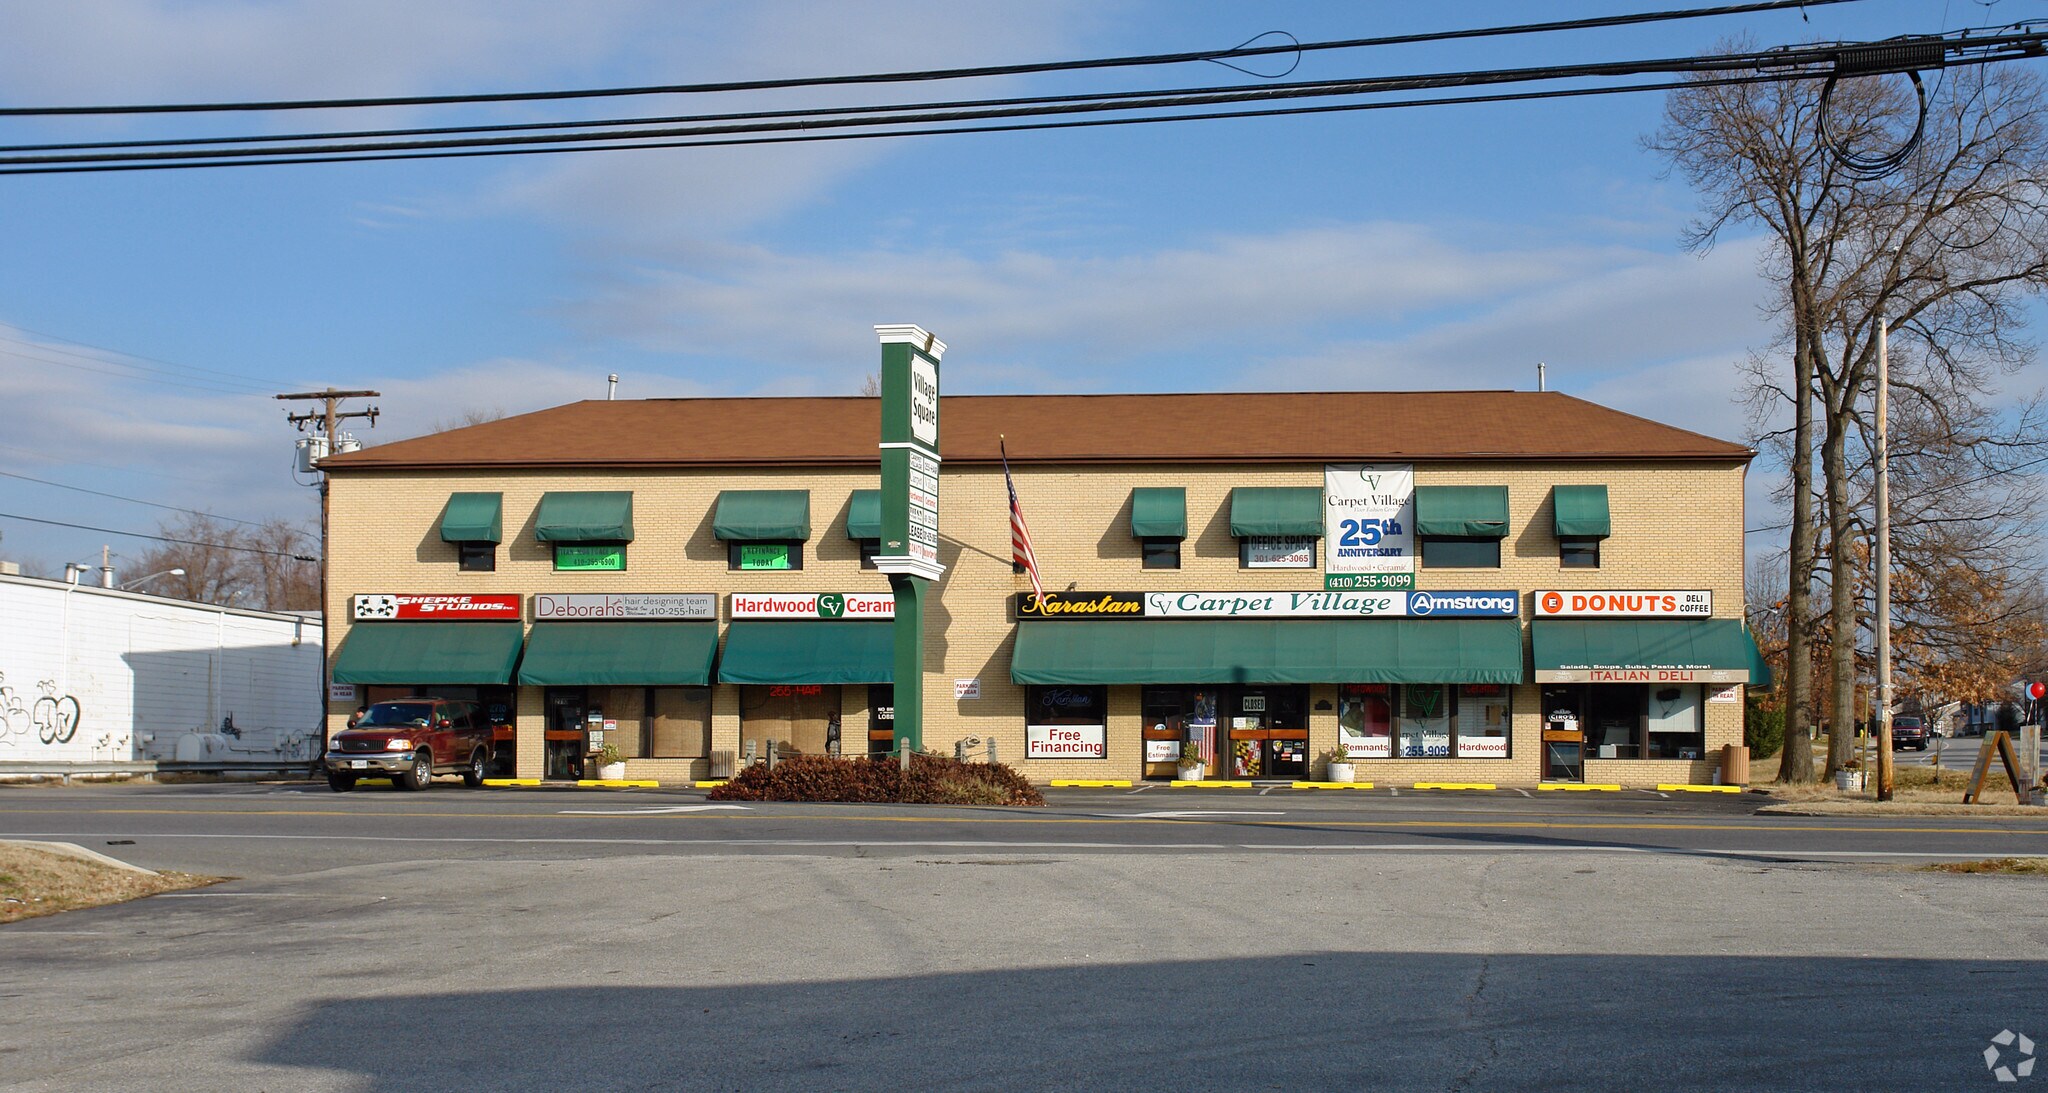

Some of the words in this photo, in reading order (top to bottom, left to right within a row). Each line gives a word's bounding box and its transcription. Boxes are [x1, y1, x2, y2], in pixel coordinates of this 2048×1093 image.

[914, 371, 935, 405] Village
[913, 397, 935, 426] Square
[1328, 495, 1367, 508] Carpet
[1371, 494, 1410, 507] Village
[1340, 518, 1403, 546] 25th
[1250, 536, 1282, 551] OFFICE
[1285, 536, 1312, 550] SPACE
[1337, 548, 1403, 557] ANNIVERSARY
[752, 559, 773, 567] TODAY
[1254, 554, 1309, 563] 301-625-3065
[1332, 564, 1371, 572] Hardwood
[1377, 563, 1406, 572] Ceramic
[1329, 577, 1353, 588] (410)
[396, 596, 472, 605] SHEPKE
[624, 596, 642, 605] hair
[643, 596, 684, 607] designing
[686, 597, 708, 605] team
[1177, 593, 1274, 614] Carpet
[1290, 592, 1391, 614] Village
[1572, 594, 1677, 612] DONUTS
[1686, 594, 1703, 602] DELI
[419, 602, 505, 612] STUDIOS
[735, 598, 816, 613] Hardwood
[1022, 593, 1140, 616] Karastan
[1411, 593, 1514, 615] Armstrong
[1679, 604, 1709, 613] COFFEE
[648, 605, 707, 616] 410-255-hair
[1590, 671, 1650, 681] ITALIAN
[1658, 671, 1693, 681] DELI
[1244, 698, 1264, 710] CLOSED
[1049, 728, 1081, 741] Free
[1031, 740, 1103, 756] Financing
[1343, 743, 1388, 751] Remnants
[1459, 743, 1507, 751] Hardwood
